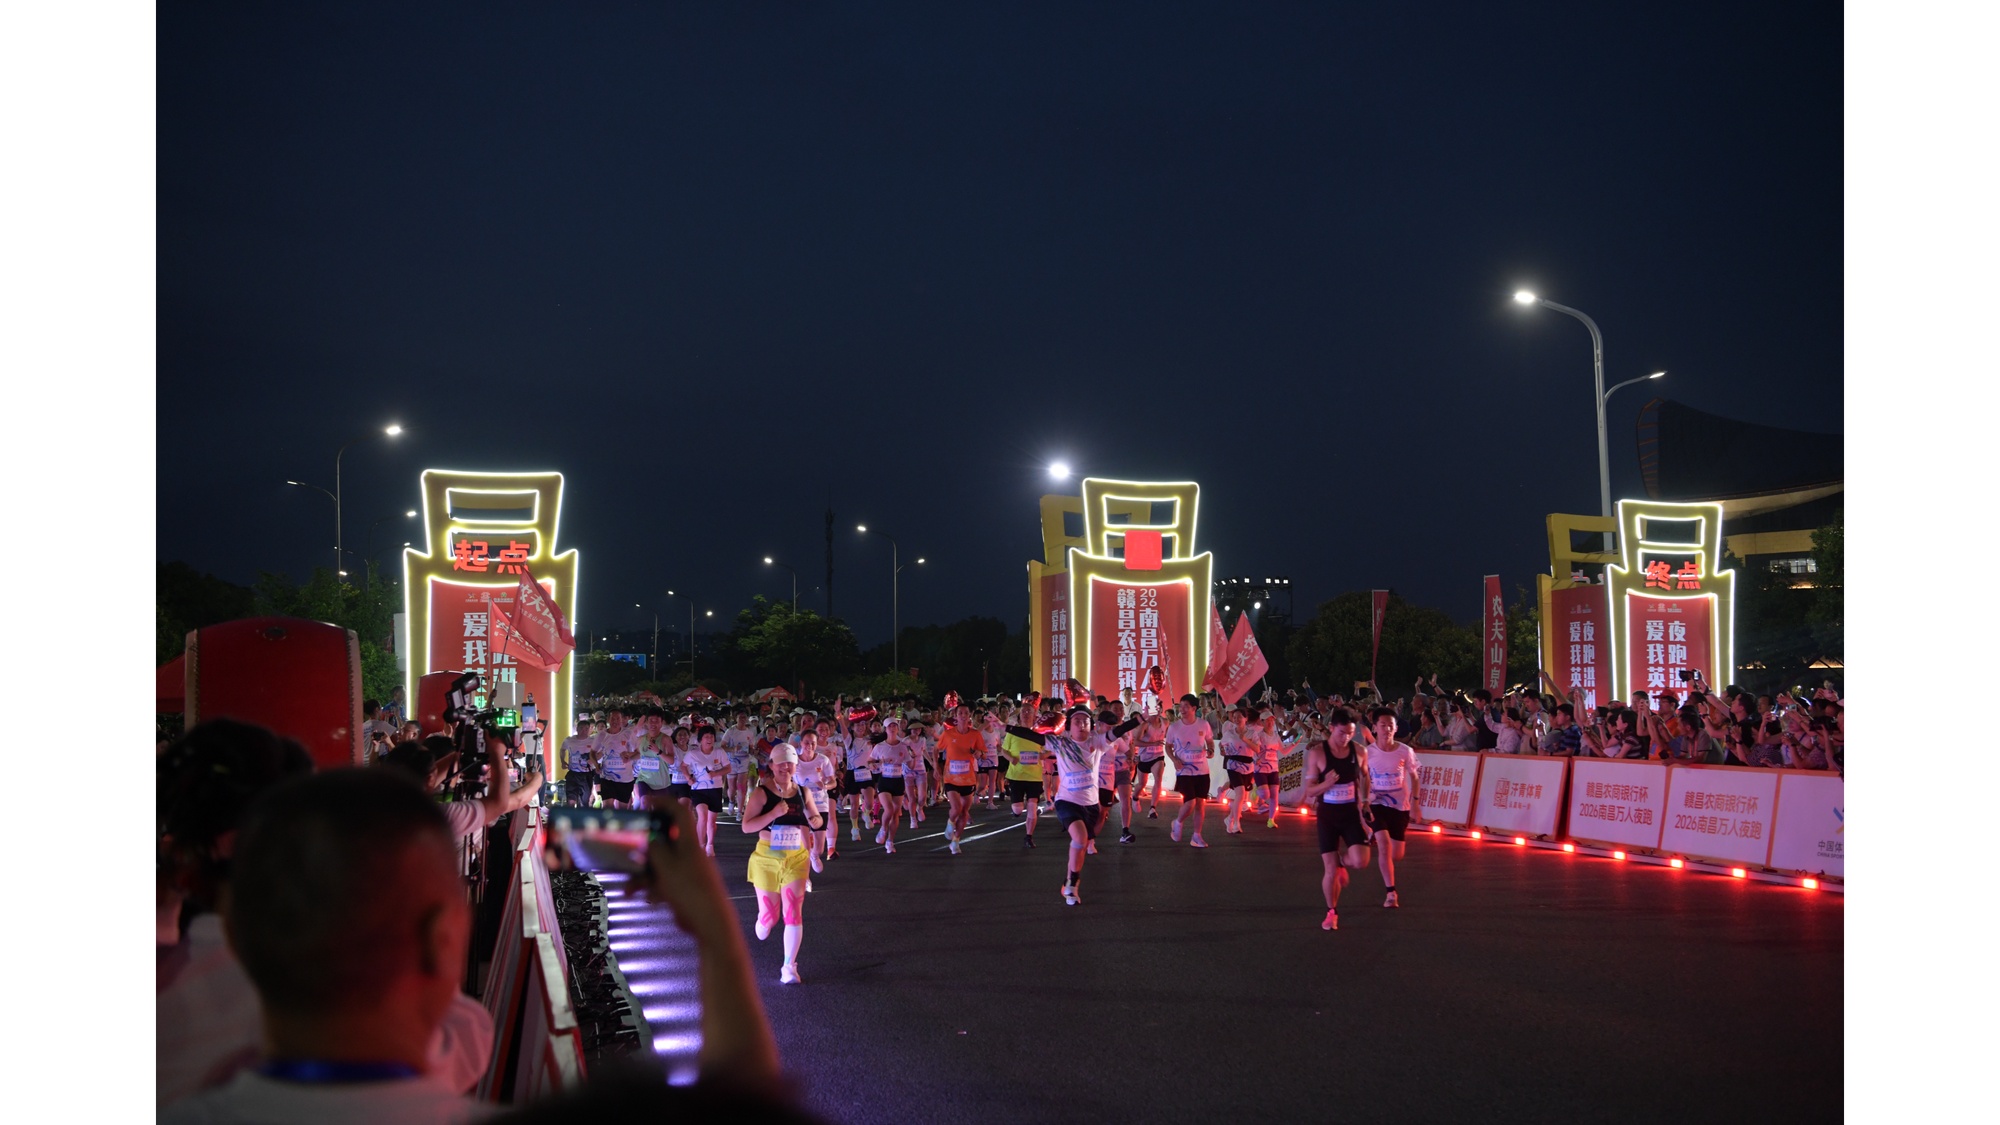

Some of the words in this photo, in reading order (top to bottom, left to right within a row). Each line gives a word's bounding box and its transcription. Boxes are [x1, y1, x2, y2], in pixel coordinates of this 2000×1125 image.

[454, 540, 530, 574] 起点
[1645, 560, 1701, 590] 终点
[1489, 595, 1504, 689] 农夫山泉
[1586, 782, 1649, 803] 赣昌农商银行杯
[1683, 791, 1759, 815] 赣昌农商银行杯
[1579, 803, 1652, 825] 2026南昌万人夜跑
[1674, 814, 1762, 840] 2026南昌万人夜跑
